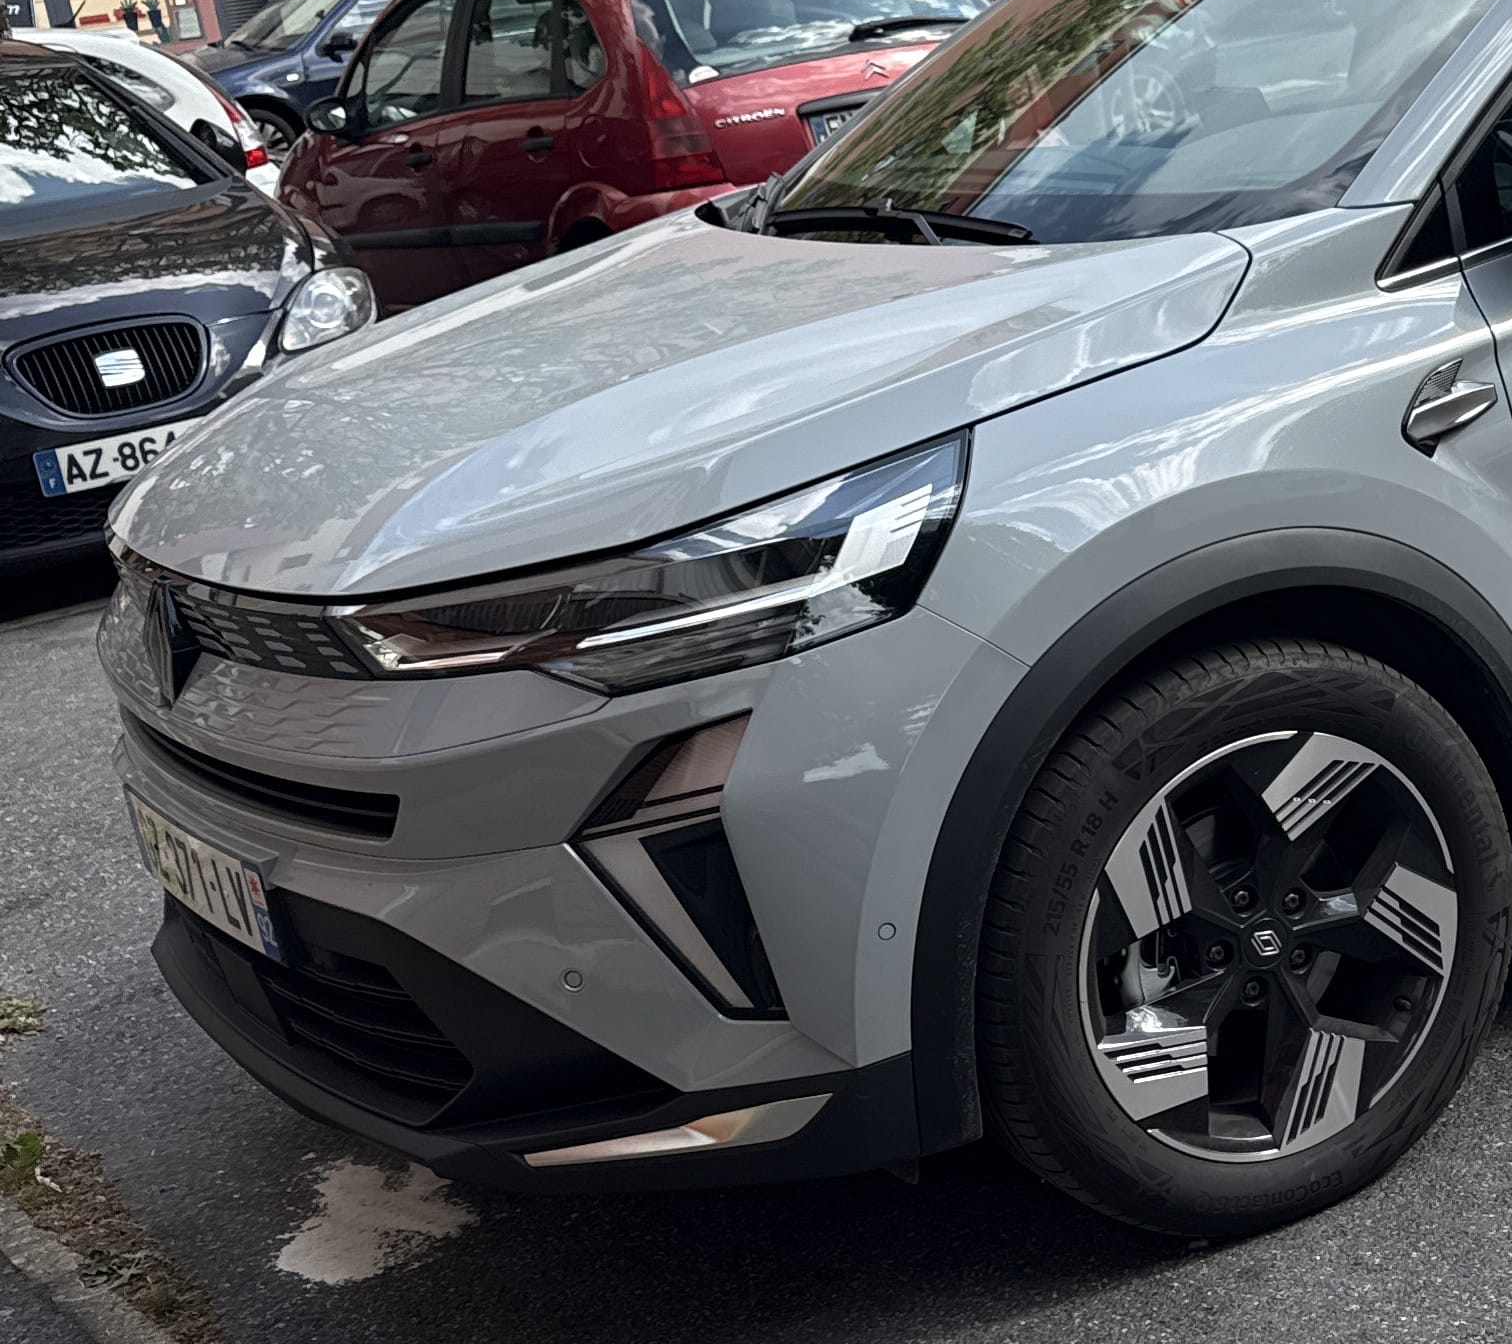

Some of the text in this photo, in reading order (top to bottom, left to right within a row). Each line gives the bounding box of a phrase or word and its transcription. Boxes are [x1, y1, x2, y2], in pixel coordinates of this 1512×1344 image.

[1042, 790, 1120, 936] 215/55 R 18 H
